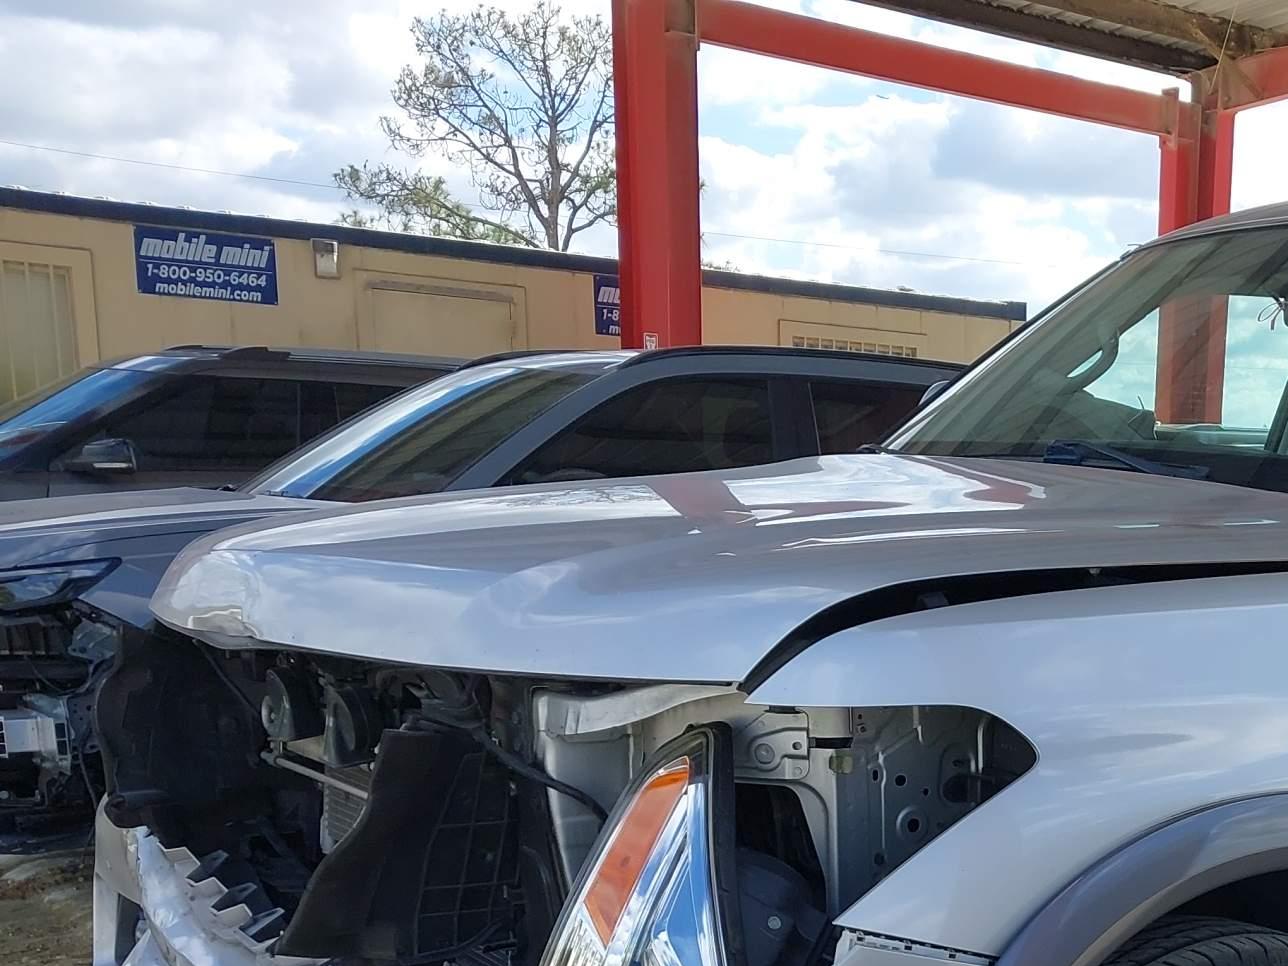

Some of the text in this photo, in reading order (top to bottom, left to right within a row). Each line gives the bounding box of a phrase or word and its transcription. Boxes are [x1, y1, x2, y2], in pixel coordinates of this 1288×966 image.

[139, 232, 270, 268] mobile mini
[146, 264, 267, 287] 1-800-950-6464
[155, 282, 262, 302] mobilemini.com
